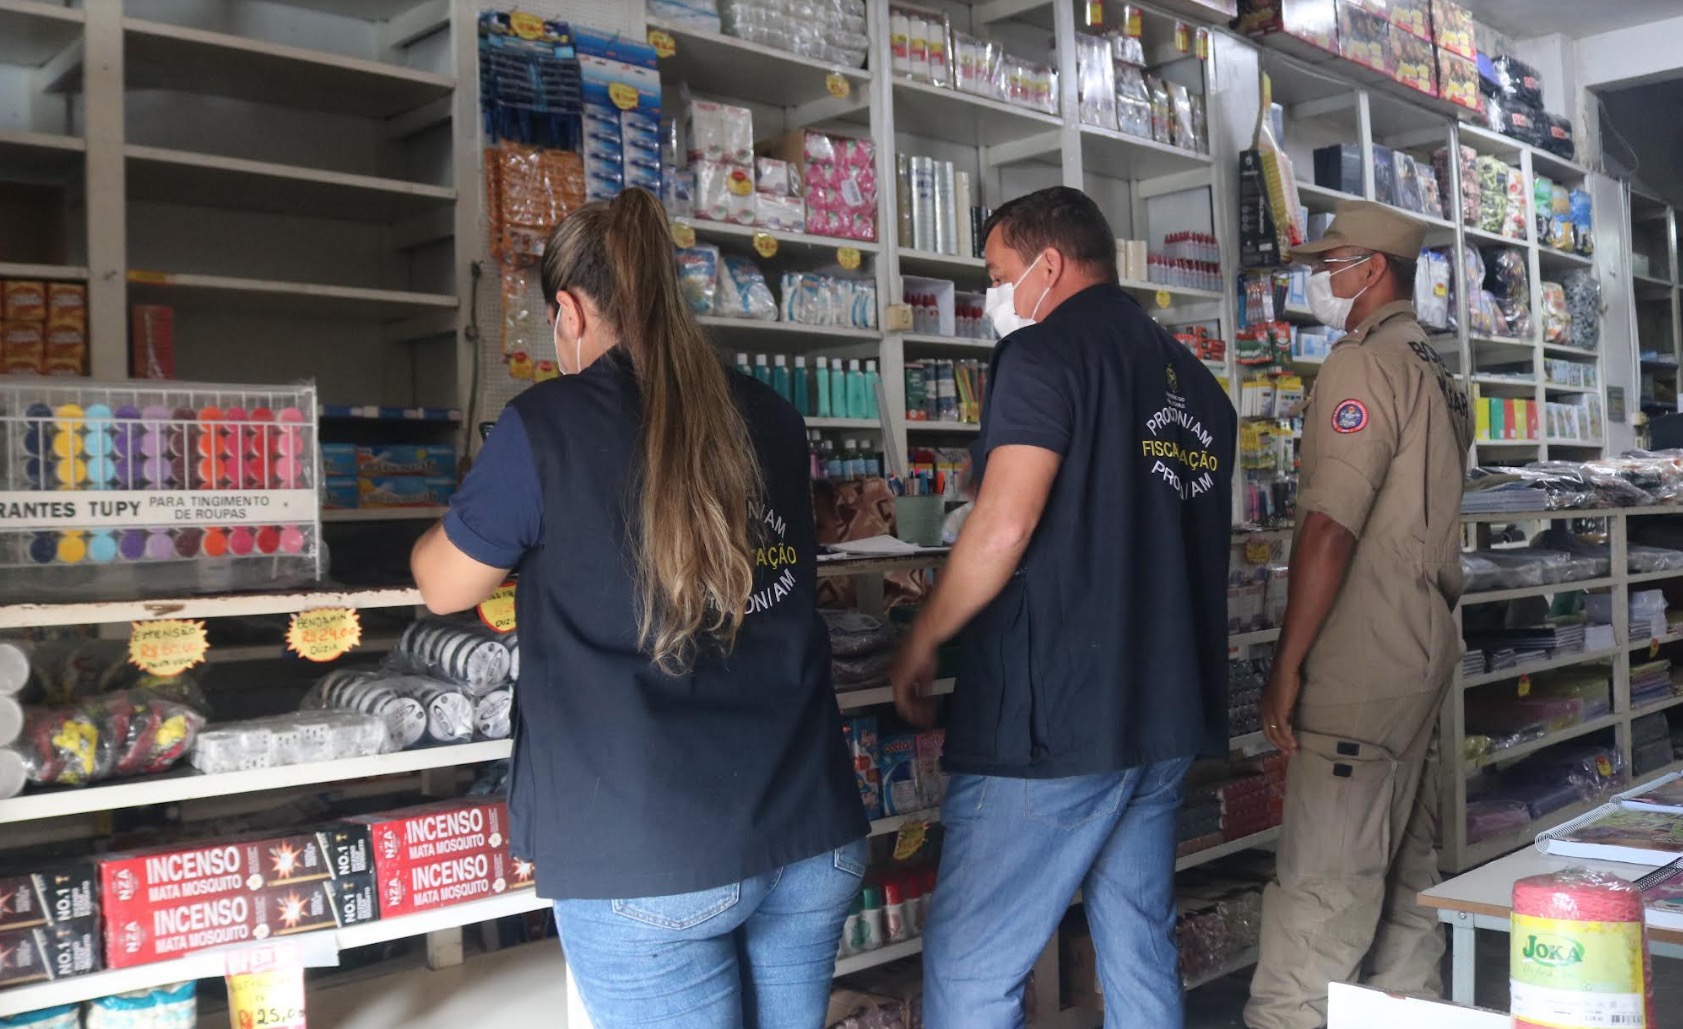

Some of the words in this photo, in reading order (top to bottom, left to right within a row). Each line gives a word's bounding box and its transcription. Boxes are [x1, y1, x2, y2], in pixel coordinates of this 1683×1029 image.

[88, 500, 142, 517] TUPY
[149, 496, 186, 507] PARA
[190, 495, 270, 507] TINGIMENTO
[174, 508, 192, 520] DE
[195, 507, 247, 519] ROUPAS
[405, 808, 483, 845] INCENSO
[382, 830, 396, 859] NZA
[409, 843, 436, 860] MATA
[436, 833, 486, 854] MOSQUITO
[145, 846, 241, 885] INCENSO
[337, 845, 351, 876] NO.1
[411, 854, 489, 892] INCENSO
[117, 868, 132, 901] NZA
[148, 884, 181, 903] MATA
[181, 873, 243, 898] MOSQUITO
[388, 877, 400, 906] NZA
[413, 889, 440, 907] MATA
[440, 879, 489, 900] MOSQUITO
[56, 888, 72, 921] NO.1
[153, 896, 248, 937] INCENSO
[343, 893, 356, 924] NO.1
[124, 921, 138, 954] NZA
[156, 935, 188, 955] MATA
[188, 924, 249, 949] MOSQUITO
[57, 941, 73, 975] NO.1
